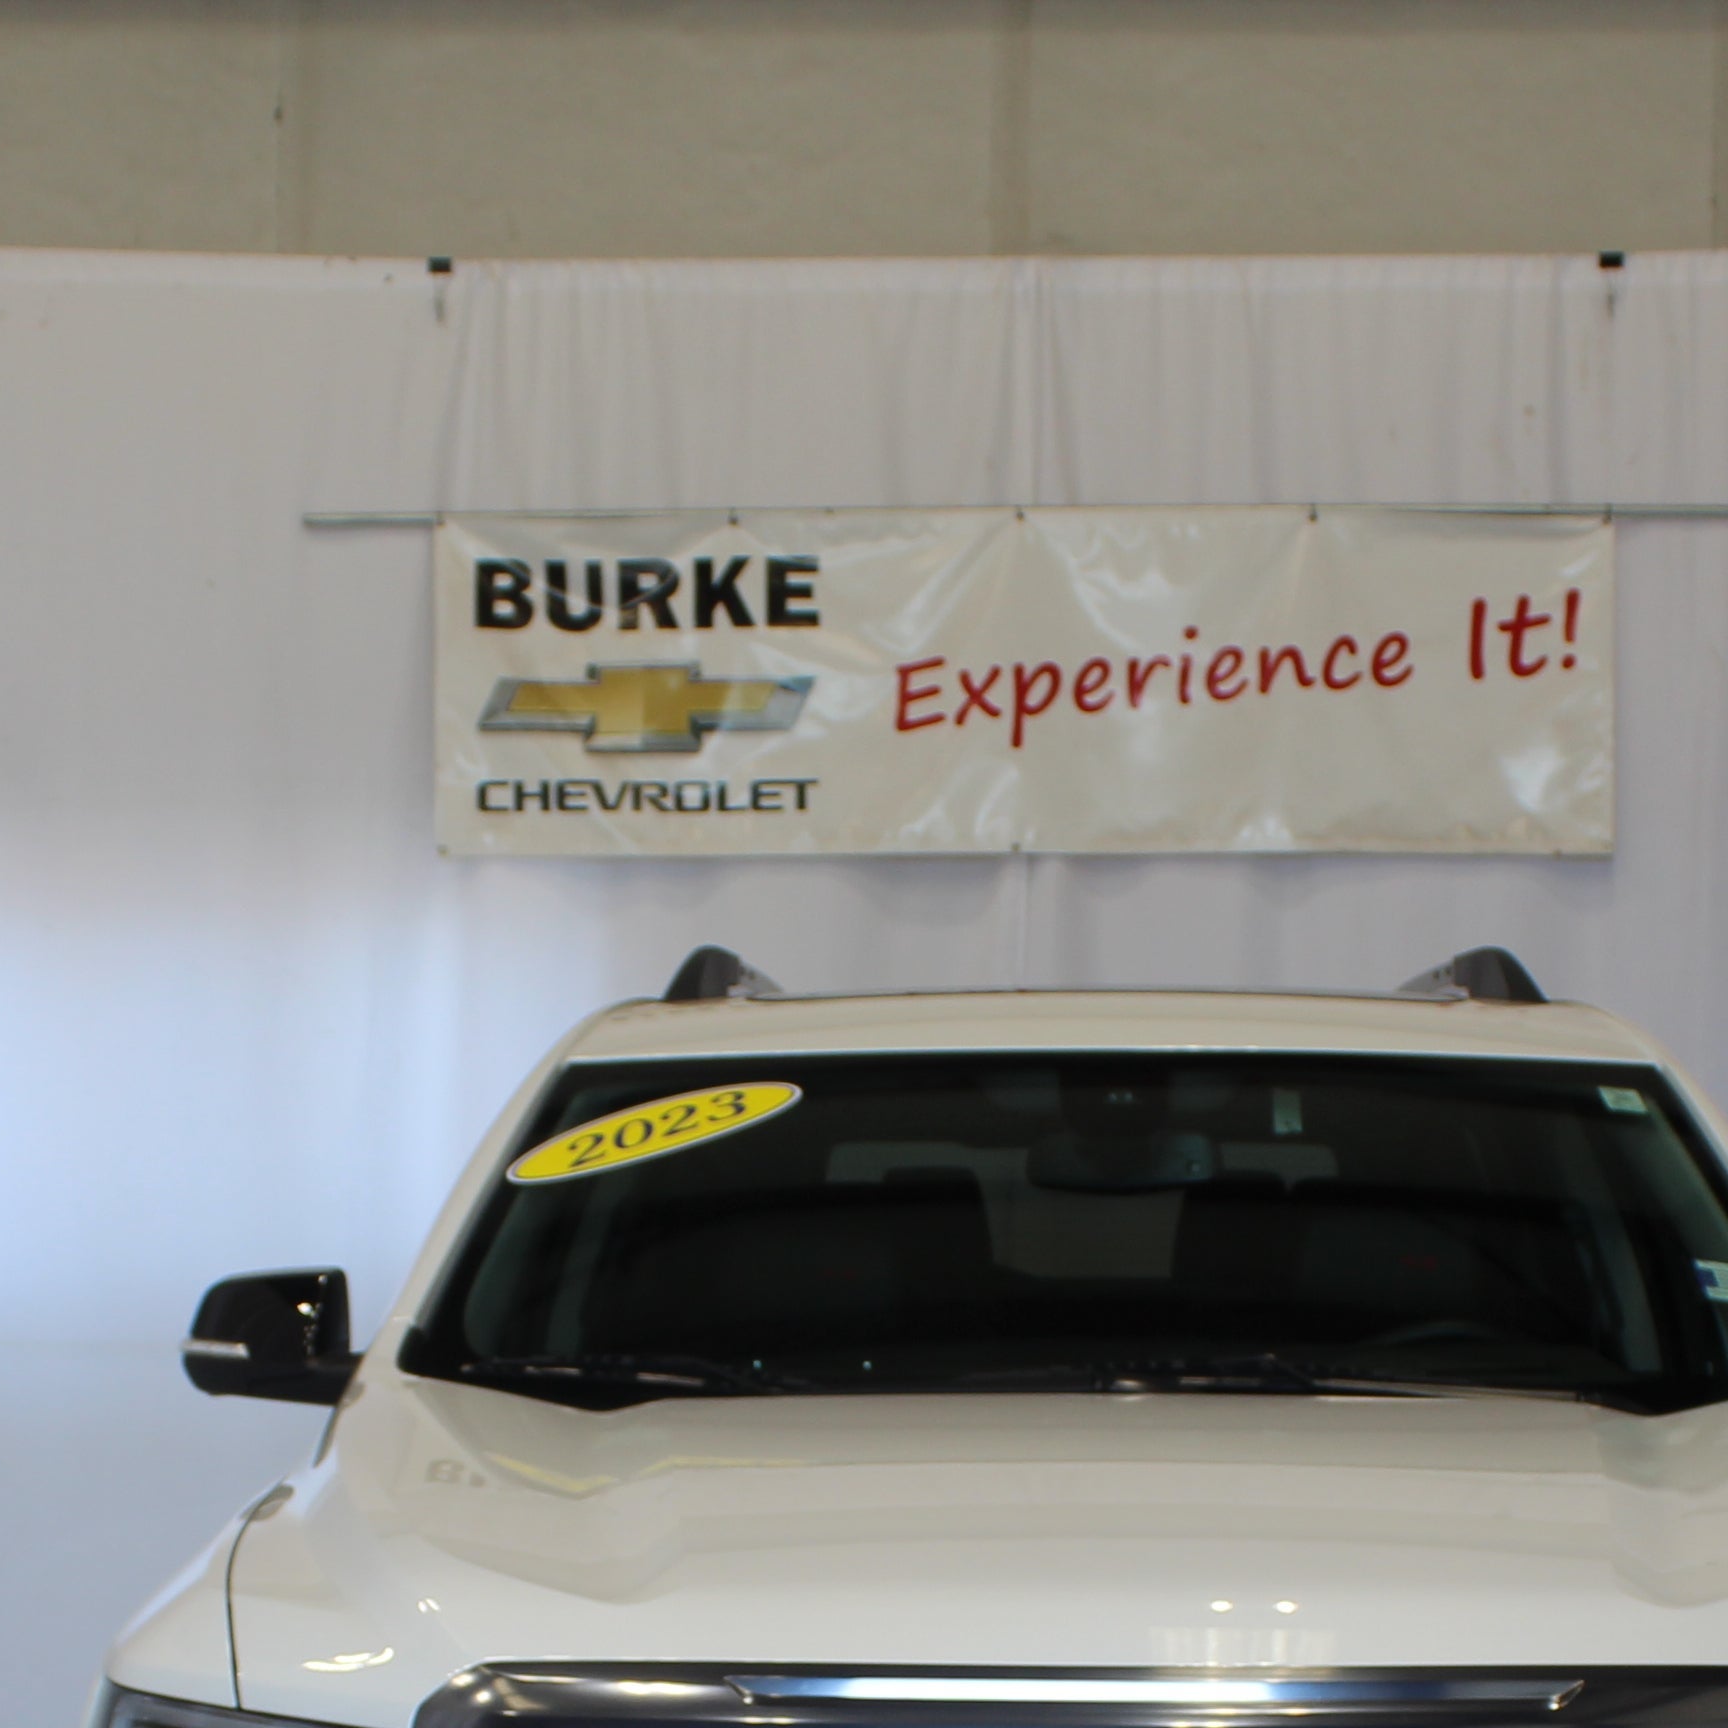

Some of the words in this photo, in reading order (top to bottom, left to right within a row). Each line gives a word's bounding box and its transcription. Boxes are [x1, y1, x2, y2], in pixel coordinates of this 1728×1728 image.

[475, 556, 820, 630] BURKE
[894, 626, 1413, 747] Experience
[1467, 589, 1582, 681] It!
[477, 778, 818, 813] CHEVROLET
[568, 1090, 747, 1167] 2023
